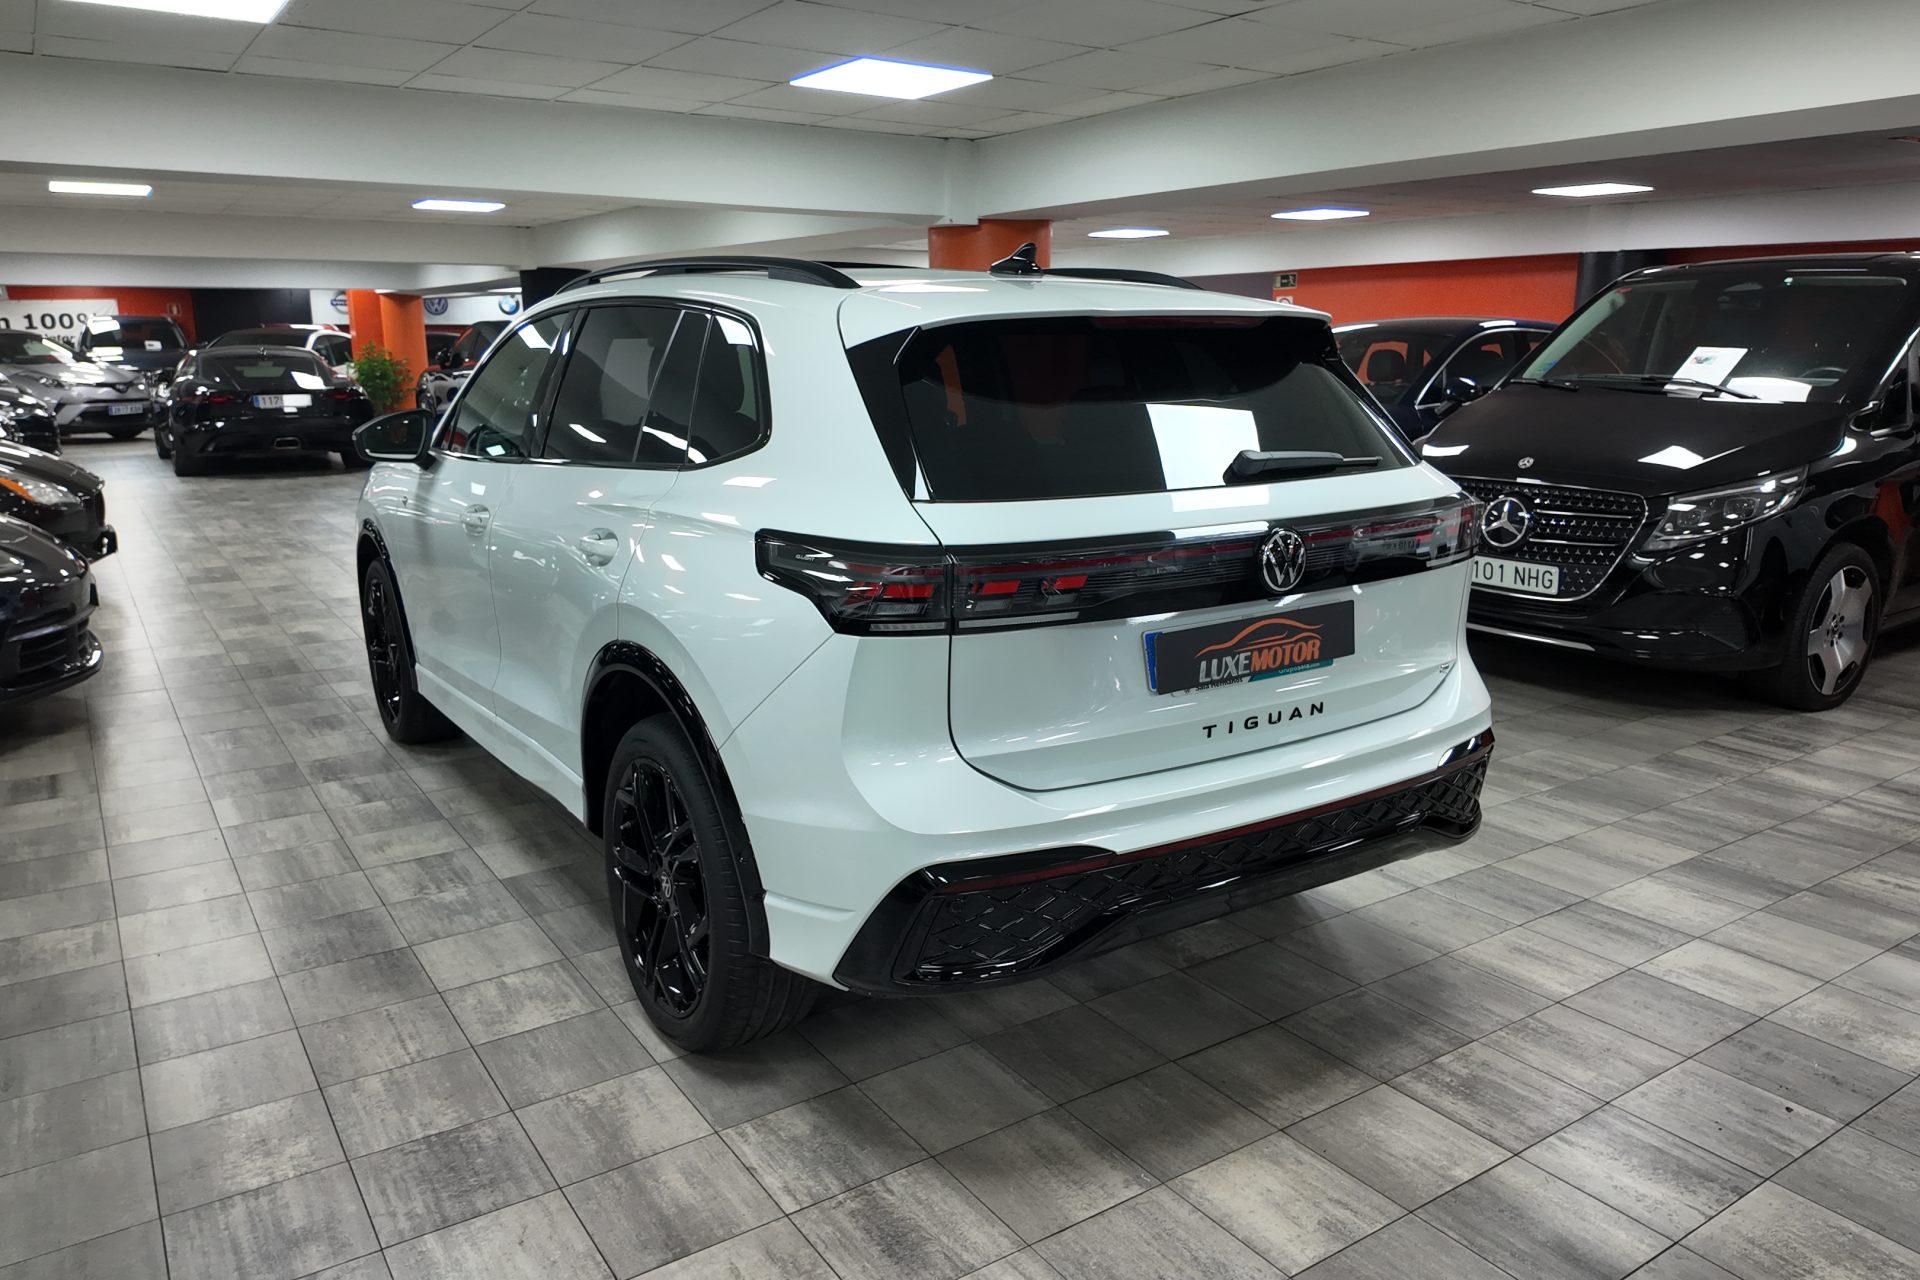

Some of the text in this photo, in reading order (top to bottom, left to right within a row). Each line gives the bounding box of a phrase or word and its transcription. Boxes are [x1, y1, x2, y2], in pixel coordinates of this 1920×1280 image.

[261, 395, 283, 408] 117
[1514, 566, 1553, 589] NHG
[1199, 639, 1321, 683] LUXEMOTOR
[1202, 702, 1324, 738] TIGUAN
